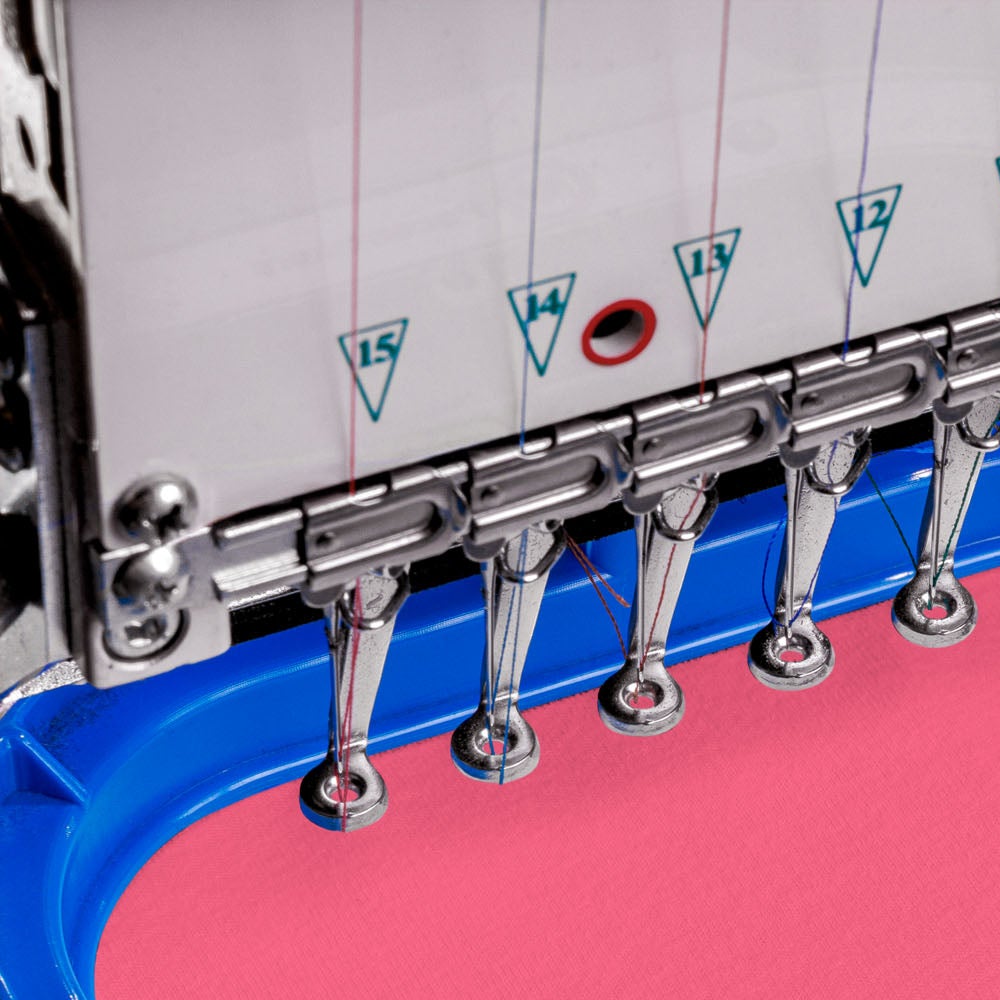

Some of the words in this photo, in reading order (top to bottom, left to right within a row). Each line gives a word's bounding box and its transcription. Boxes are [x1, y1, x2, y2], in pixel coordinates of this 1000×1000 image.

[851, 198, 891, 234] 12
[689, 241, 729, 278] 13
[526, 286, 564, 323] 14
[358, 331, 398, 368] 15
